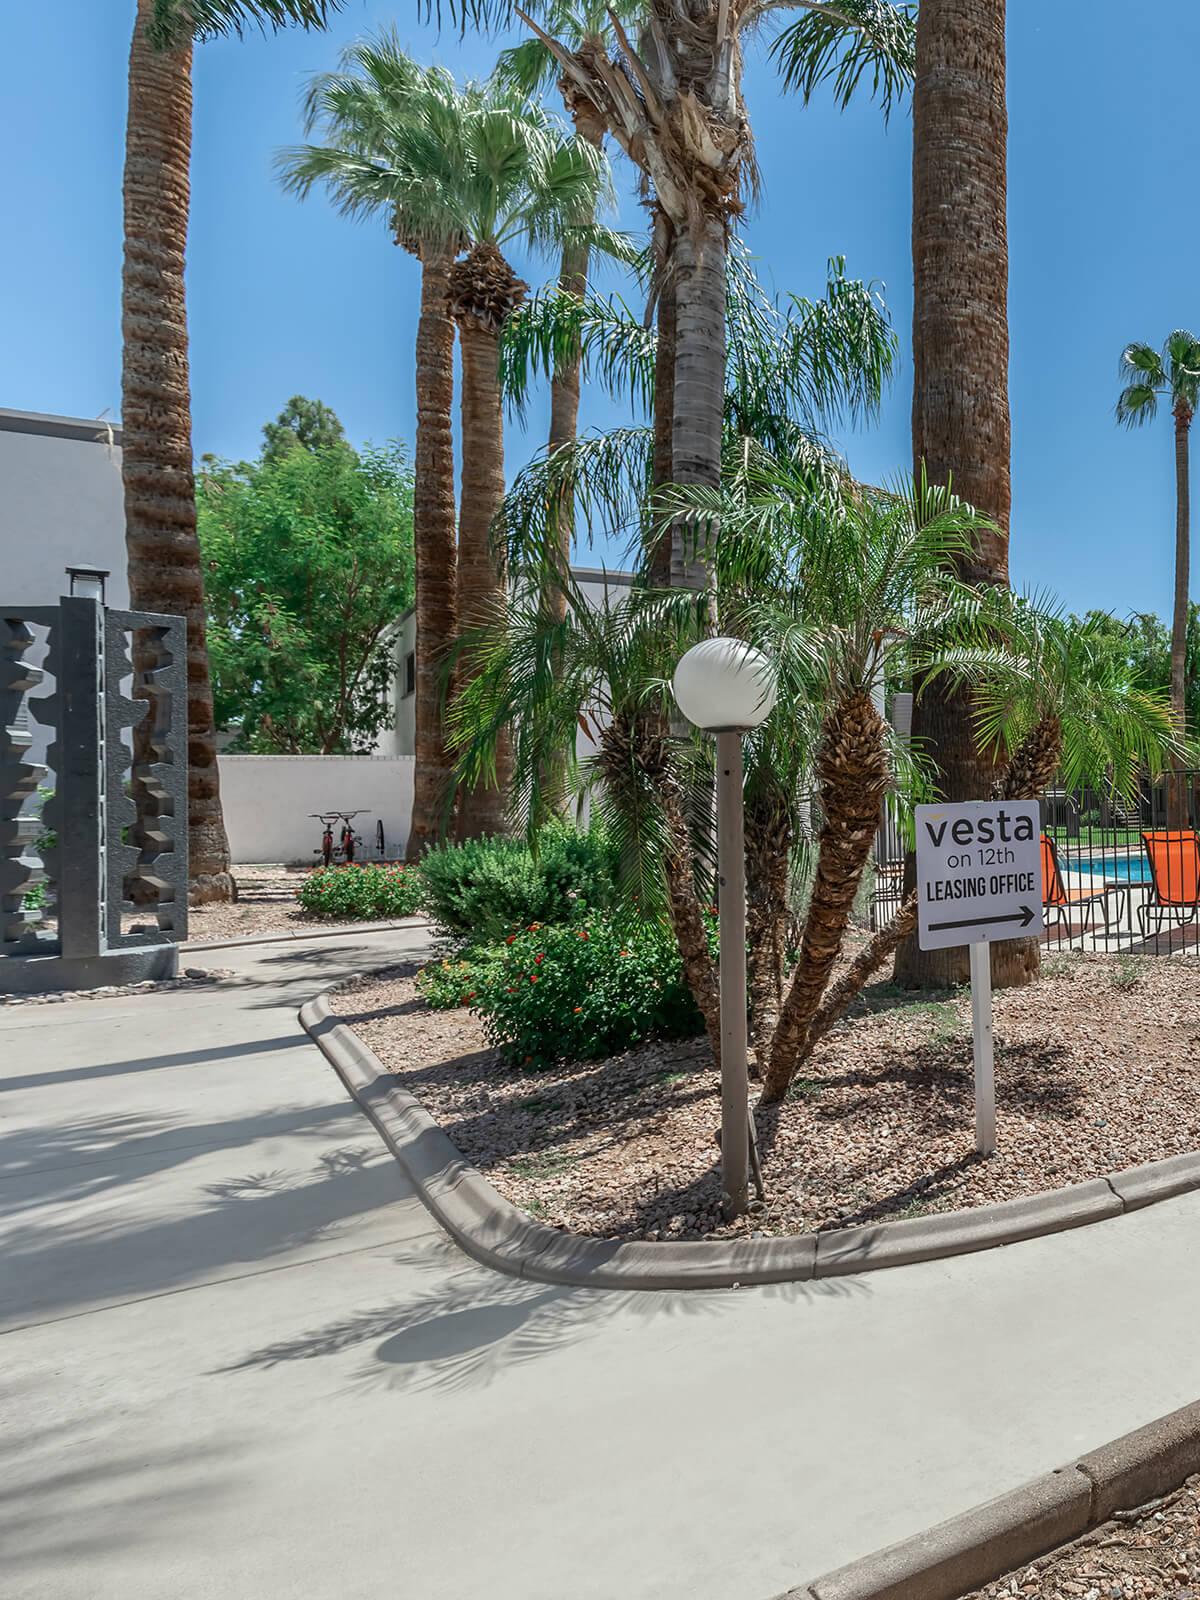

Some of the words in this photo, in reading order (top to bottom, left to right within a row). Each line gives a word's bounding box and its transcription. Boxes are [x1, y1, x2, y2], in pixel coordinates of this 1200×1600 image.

[925, 810, 1034, 847] vesta
[947, 854, 971, 868] on
[978, 847, 1015, 866] 12th
[927, 877, 986, 902] LEASING
[990, 872, 1035, 895] OFFICE
